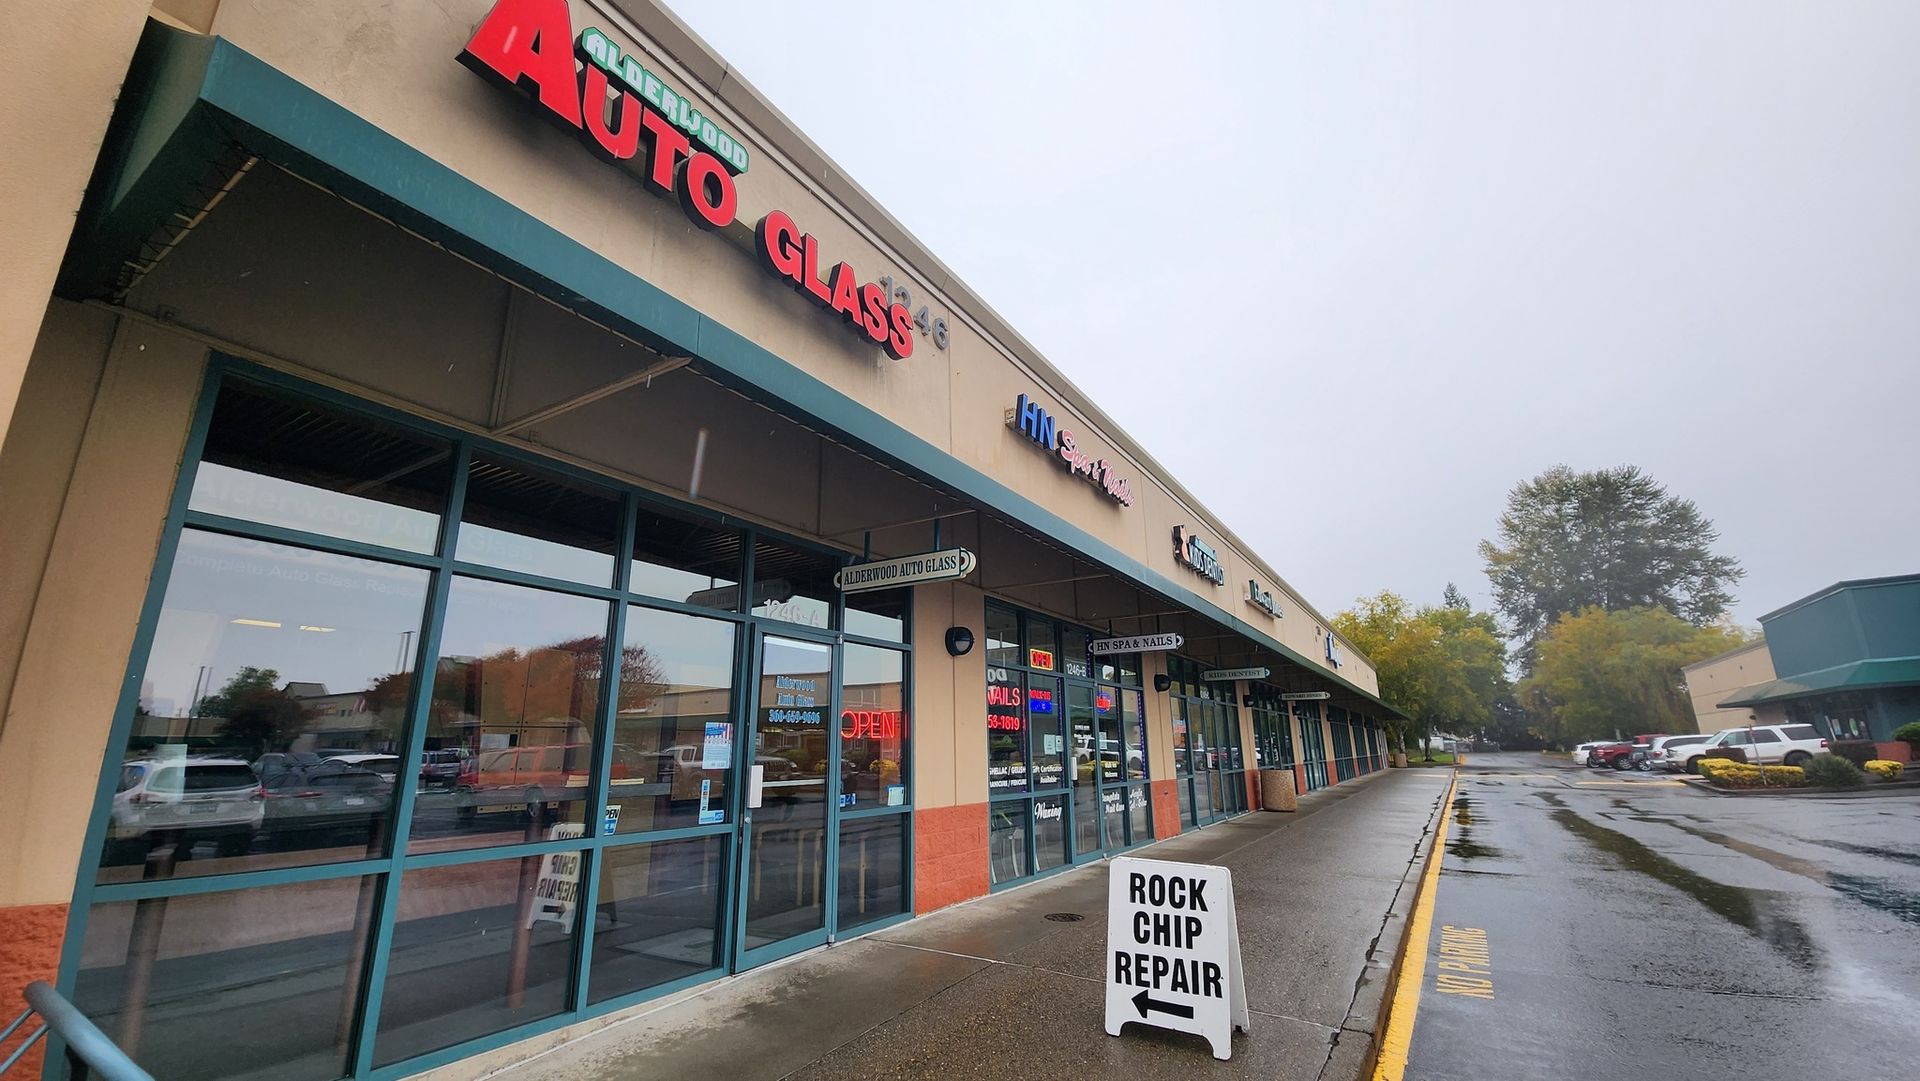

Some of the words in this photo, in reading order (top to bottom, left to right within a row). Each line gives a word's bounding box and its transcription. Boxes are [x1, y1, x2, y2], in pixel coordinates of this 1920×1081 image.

[583, 28, 749, 172] ALDERWOOD
[465, 0, 737, 227] AUTO
[758, 210, 914, 359] GLASS
[1015, 393, 1056, 450] HN
[1058, 429, 1092, 474] Spa
[1099, 459, 1134, 506] Nails
[843, 564, 898, 585] ALDERWOOD
[899, 560, 923, 578] AUTO
[925, 556, 957, 573] GLASS
[763, 599, 820, 627] 1246-A
[1097, 642, 1110, 651] HN
[1112, 639, 1131, 650] SPA
[1132, 639, 1141, 648] &
[1143, 636, 1174, 648] NAILS
[1032, 651, 1052, 668] OPEN
[1066, 663, 1087, 677] 1246-B
[1228, 669, 1260, 677] DENTIST
[840, 710, 895, 739] OPEN
[1034, 802, 1062, 821] Waxing
[1129, 872, 1209, 912] ROCK
[1133, 910, 1203, 950] CHIP
[1439, 924, 1492, 975] PARKING
[1115, 950, 1223, 999] REPAIR
[1436, 973, 1495, 999] NO
